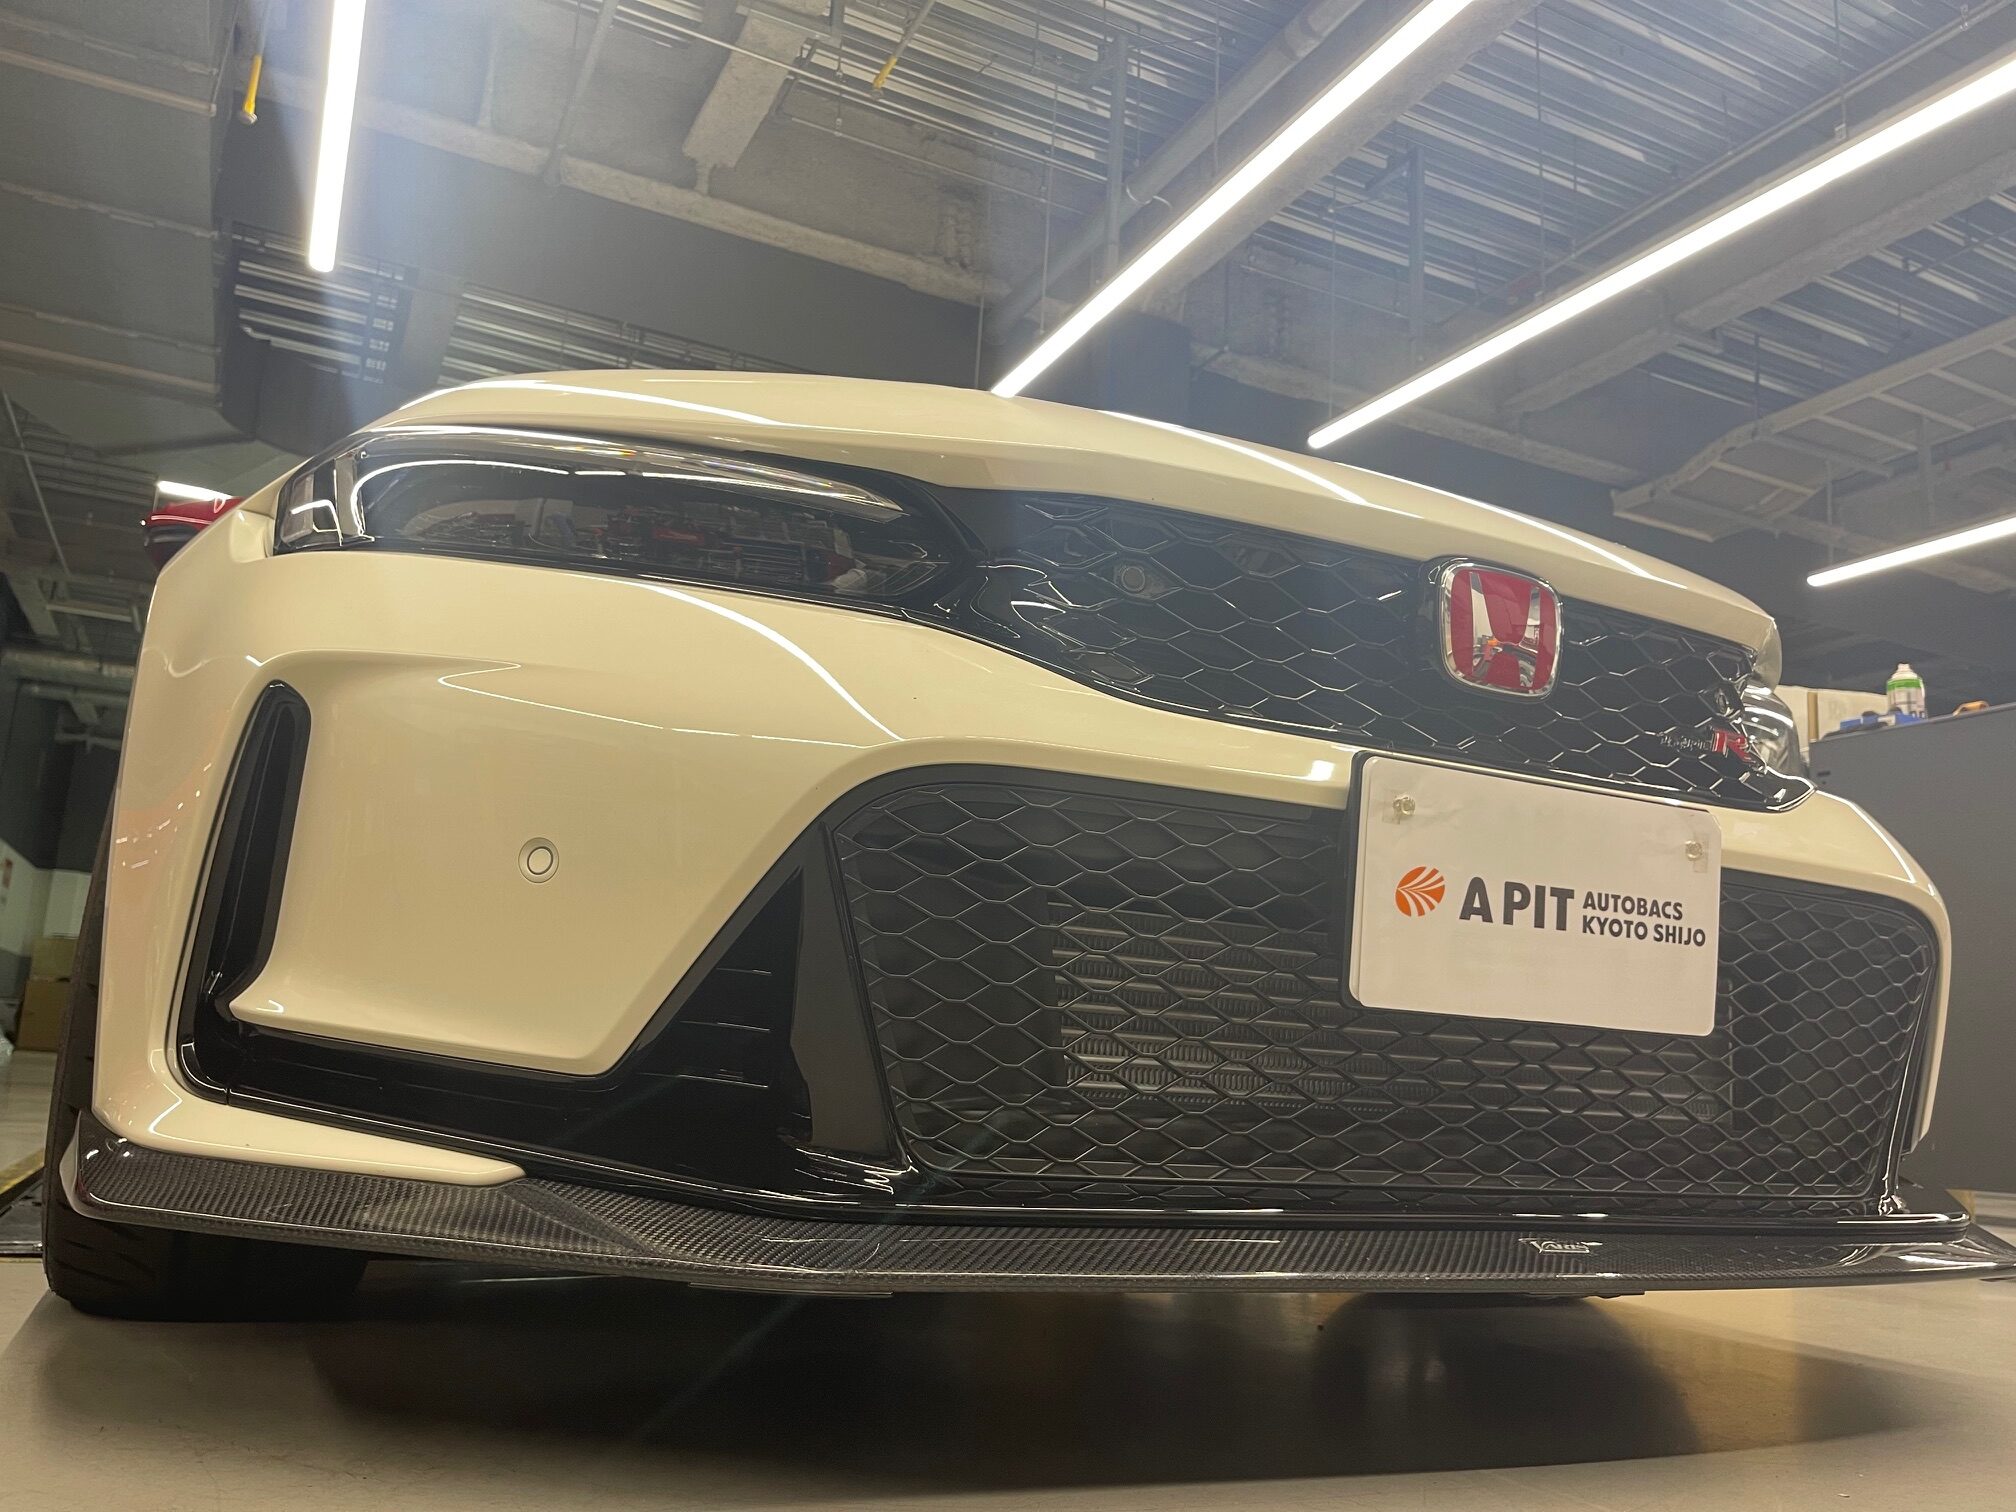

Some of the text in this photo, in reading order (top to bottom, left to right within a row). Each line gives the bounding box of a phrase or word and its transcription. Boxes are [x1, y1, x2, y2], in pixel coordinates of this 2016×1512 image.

[1502, 881, 1575, 931] PIT
[1582, 891, 1683, 921] AUTOBACS
[1582, 914, 1706, 947] KYOTO SHIJO
